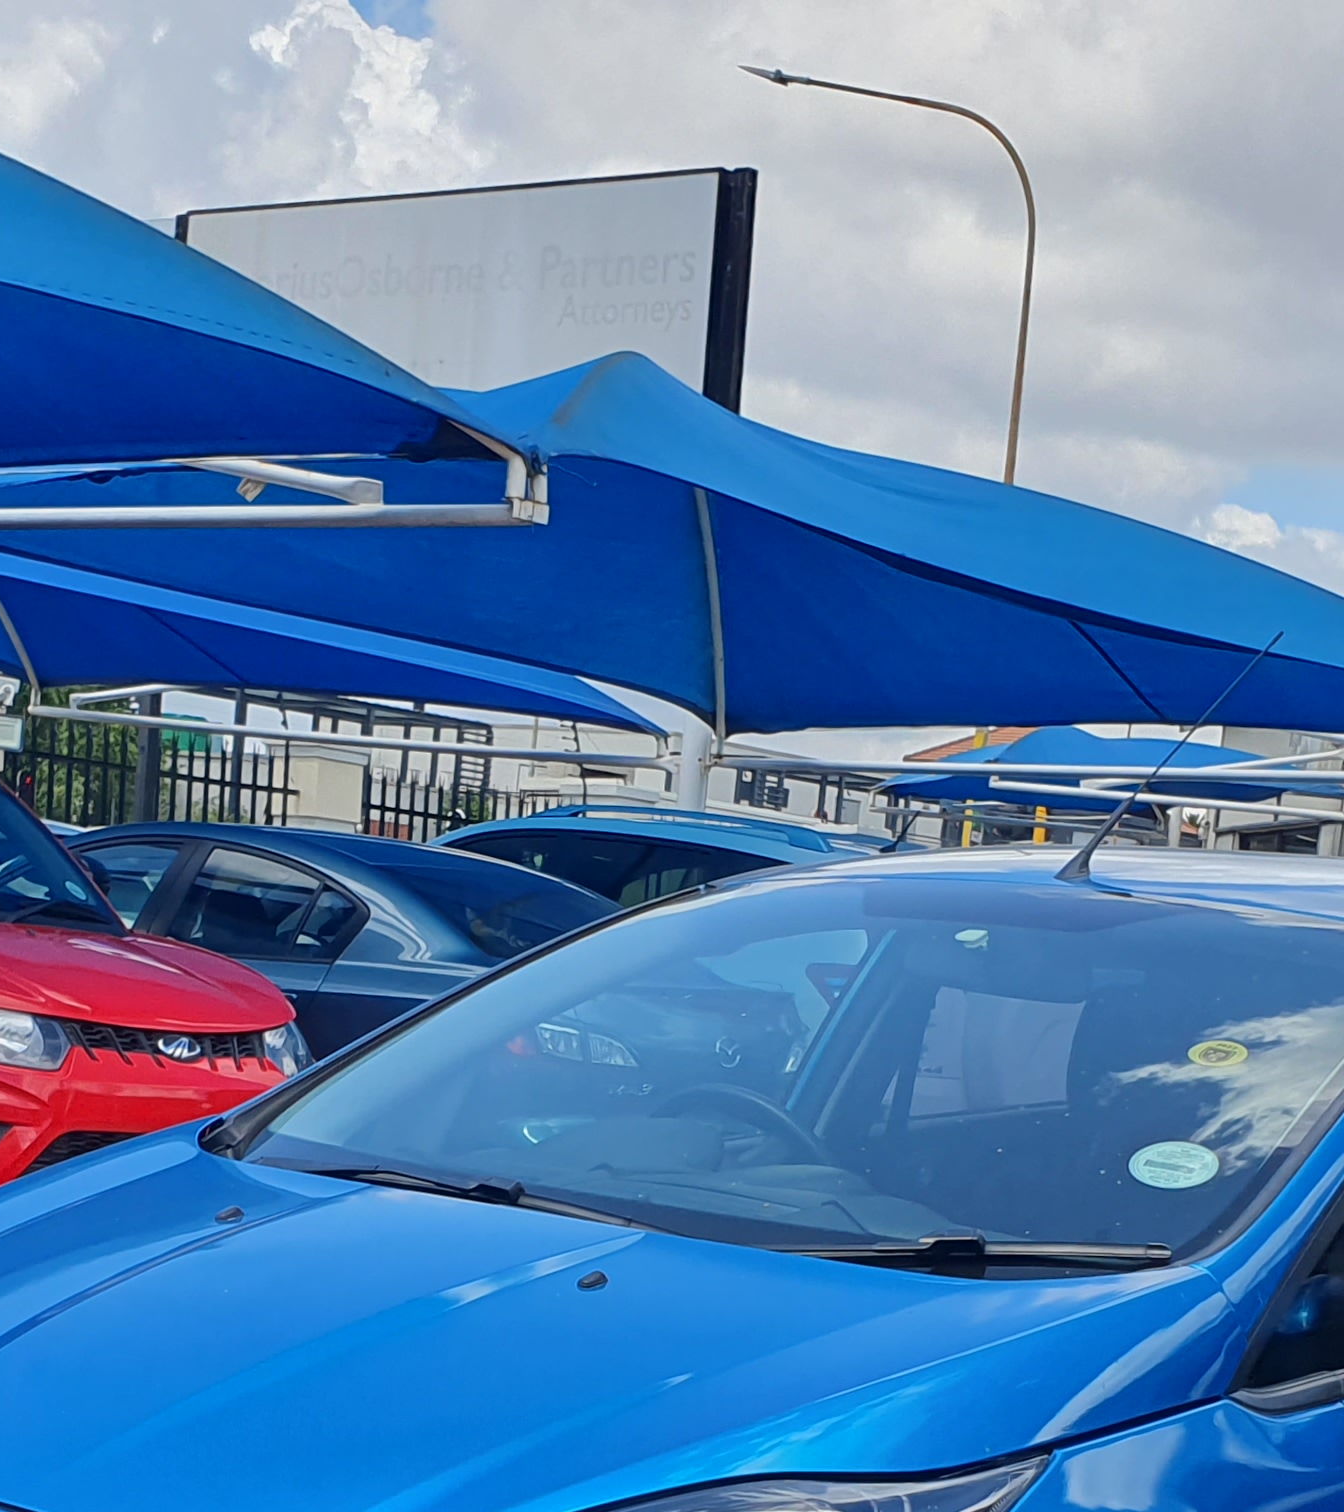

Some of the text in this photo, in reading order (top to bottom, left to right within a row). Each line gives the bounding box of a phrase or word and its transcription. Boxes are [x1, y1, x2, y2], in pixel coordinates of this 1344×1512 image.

[498, 250, 523, 292] &
[539, 243, 696, 292] Partners
[557, 294, 693, 333] Attorneys
